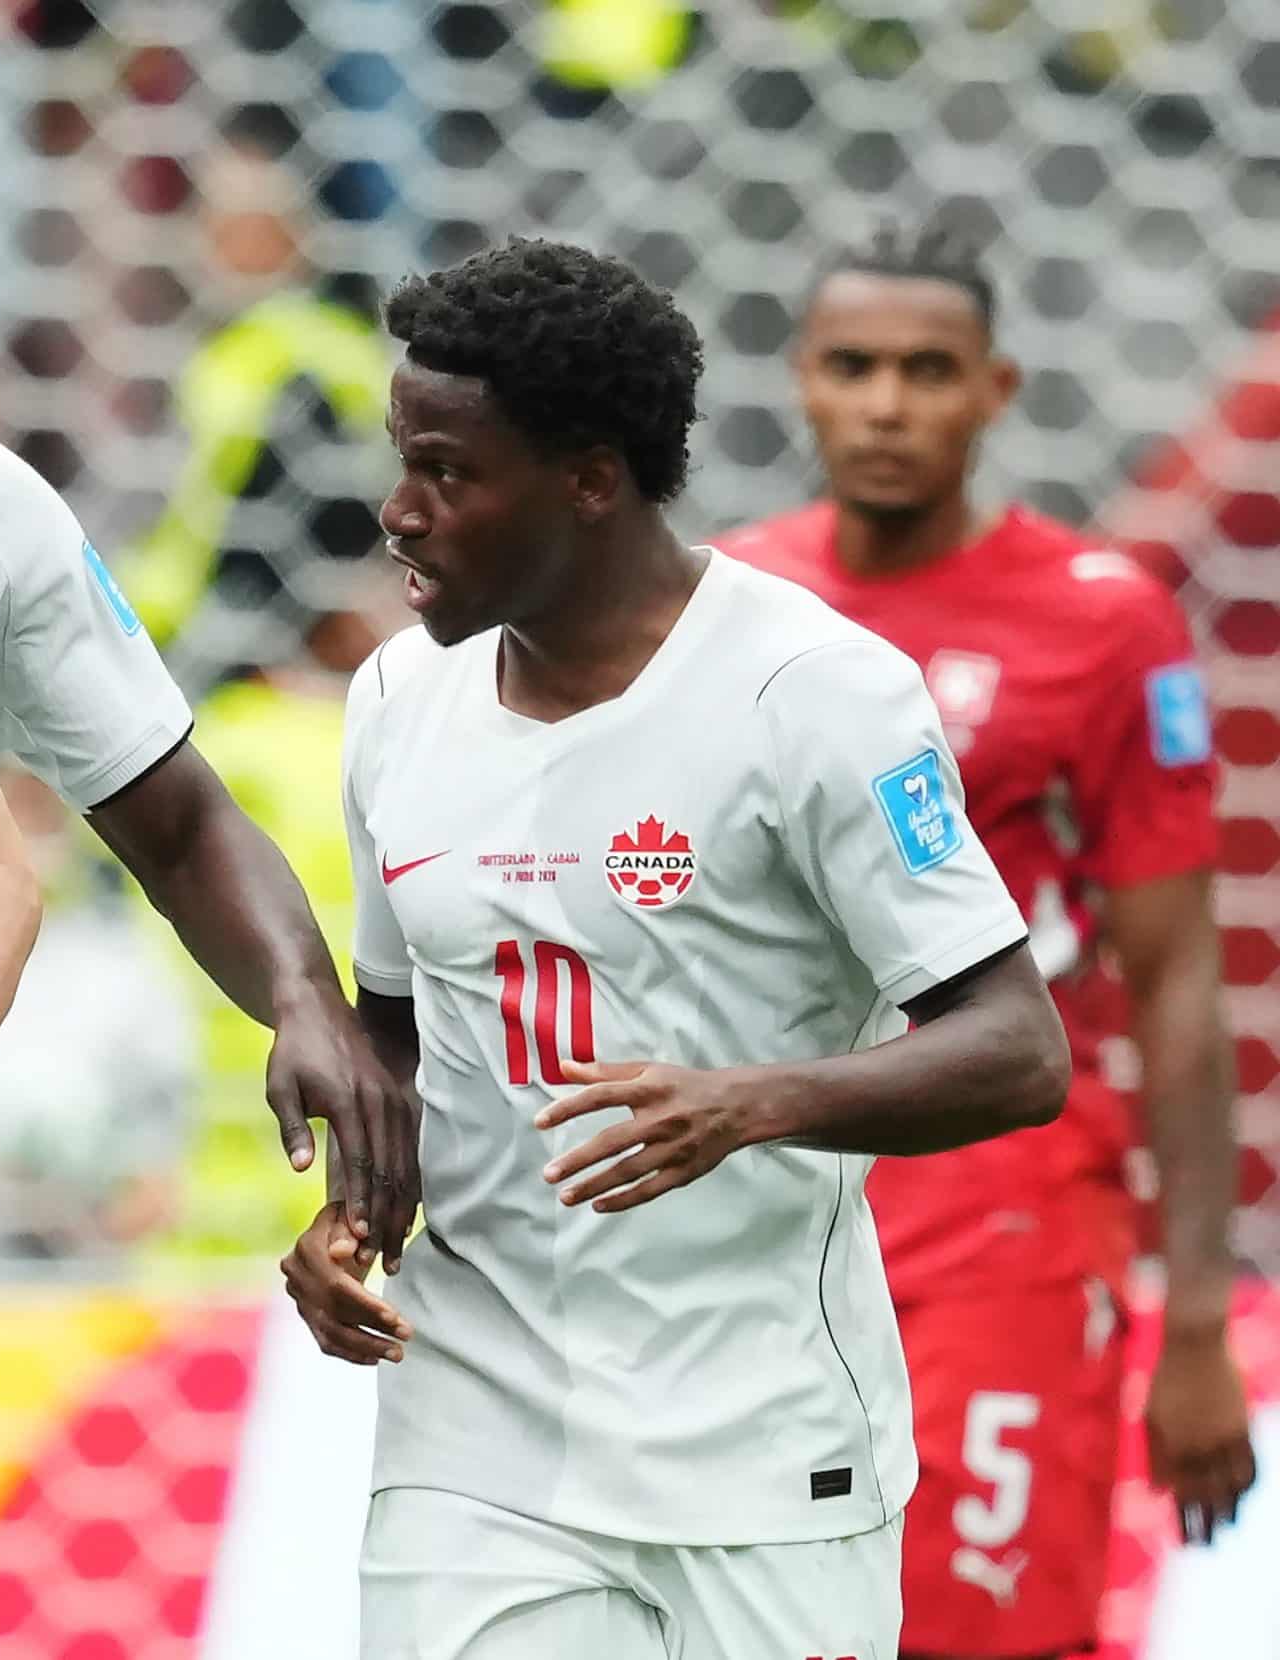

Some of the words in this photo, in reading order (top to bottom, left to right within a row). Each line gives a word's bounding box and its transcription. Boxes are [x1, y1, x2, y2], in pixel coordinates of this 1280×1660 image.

[605, 856, 695, 869] CANADA
[495, 939, 596, 1086] 10
[952, 1390, 1040, 1547] 5
